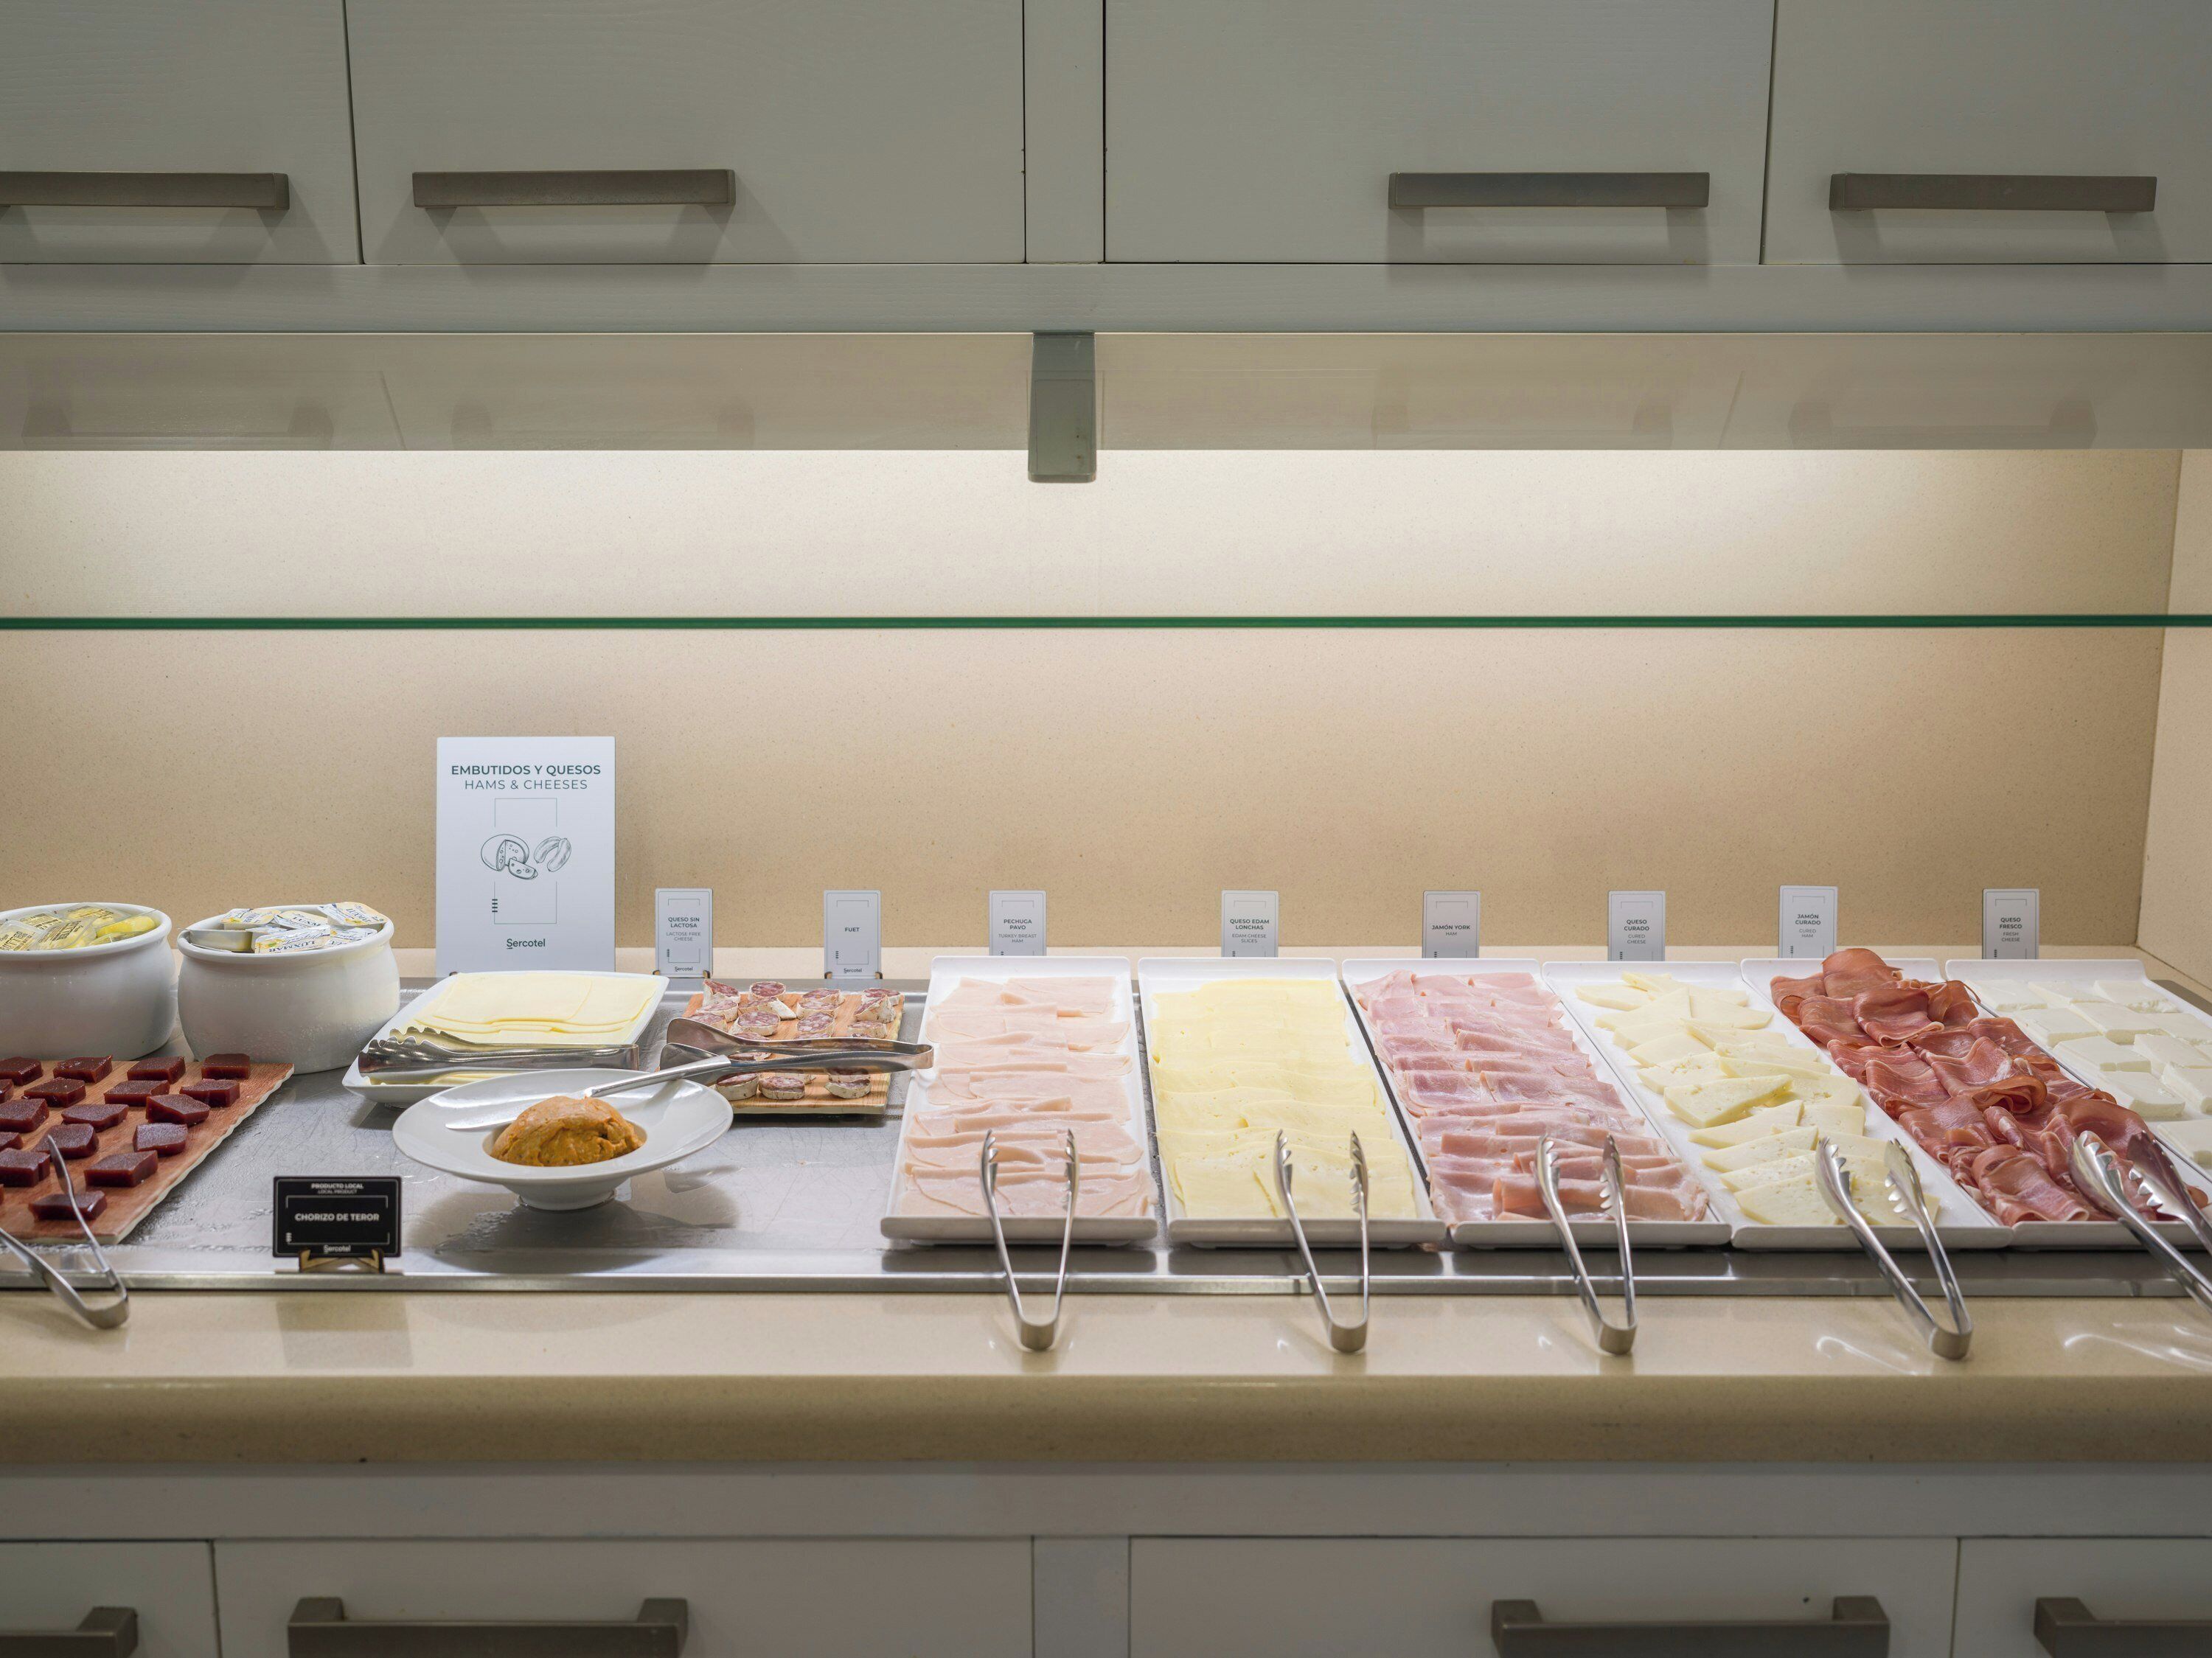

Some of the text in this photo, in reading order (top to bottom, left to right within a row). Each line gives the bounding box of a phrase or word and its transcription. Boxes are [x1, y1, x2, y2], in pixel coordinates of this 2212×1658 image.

[451, 765, 601, 776] EMBUTIDOS Y QUESOS
[465, 779, 588, 790] HAMS & CHEESES
[269, 940, 315, 952] LUXMAR
[507, 938, 546, 950] Sercotel
[294, 1213, 380, 1222] CHORIZO DE TEROR
[324, 1245, 351, 1254] Sercotel
